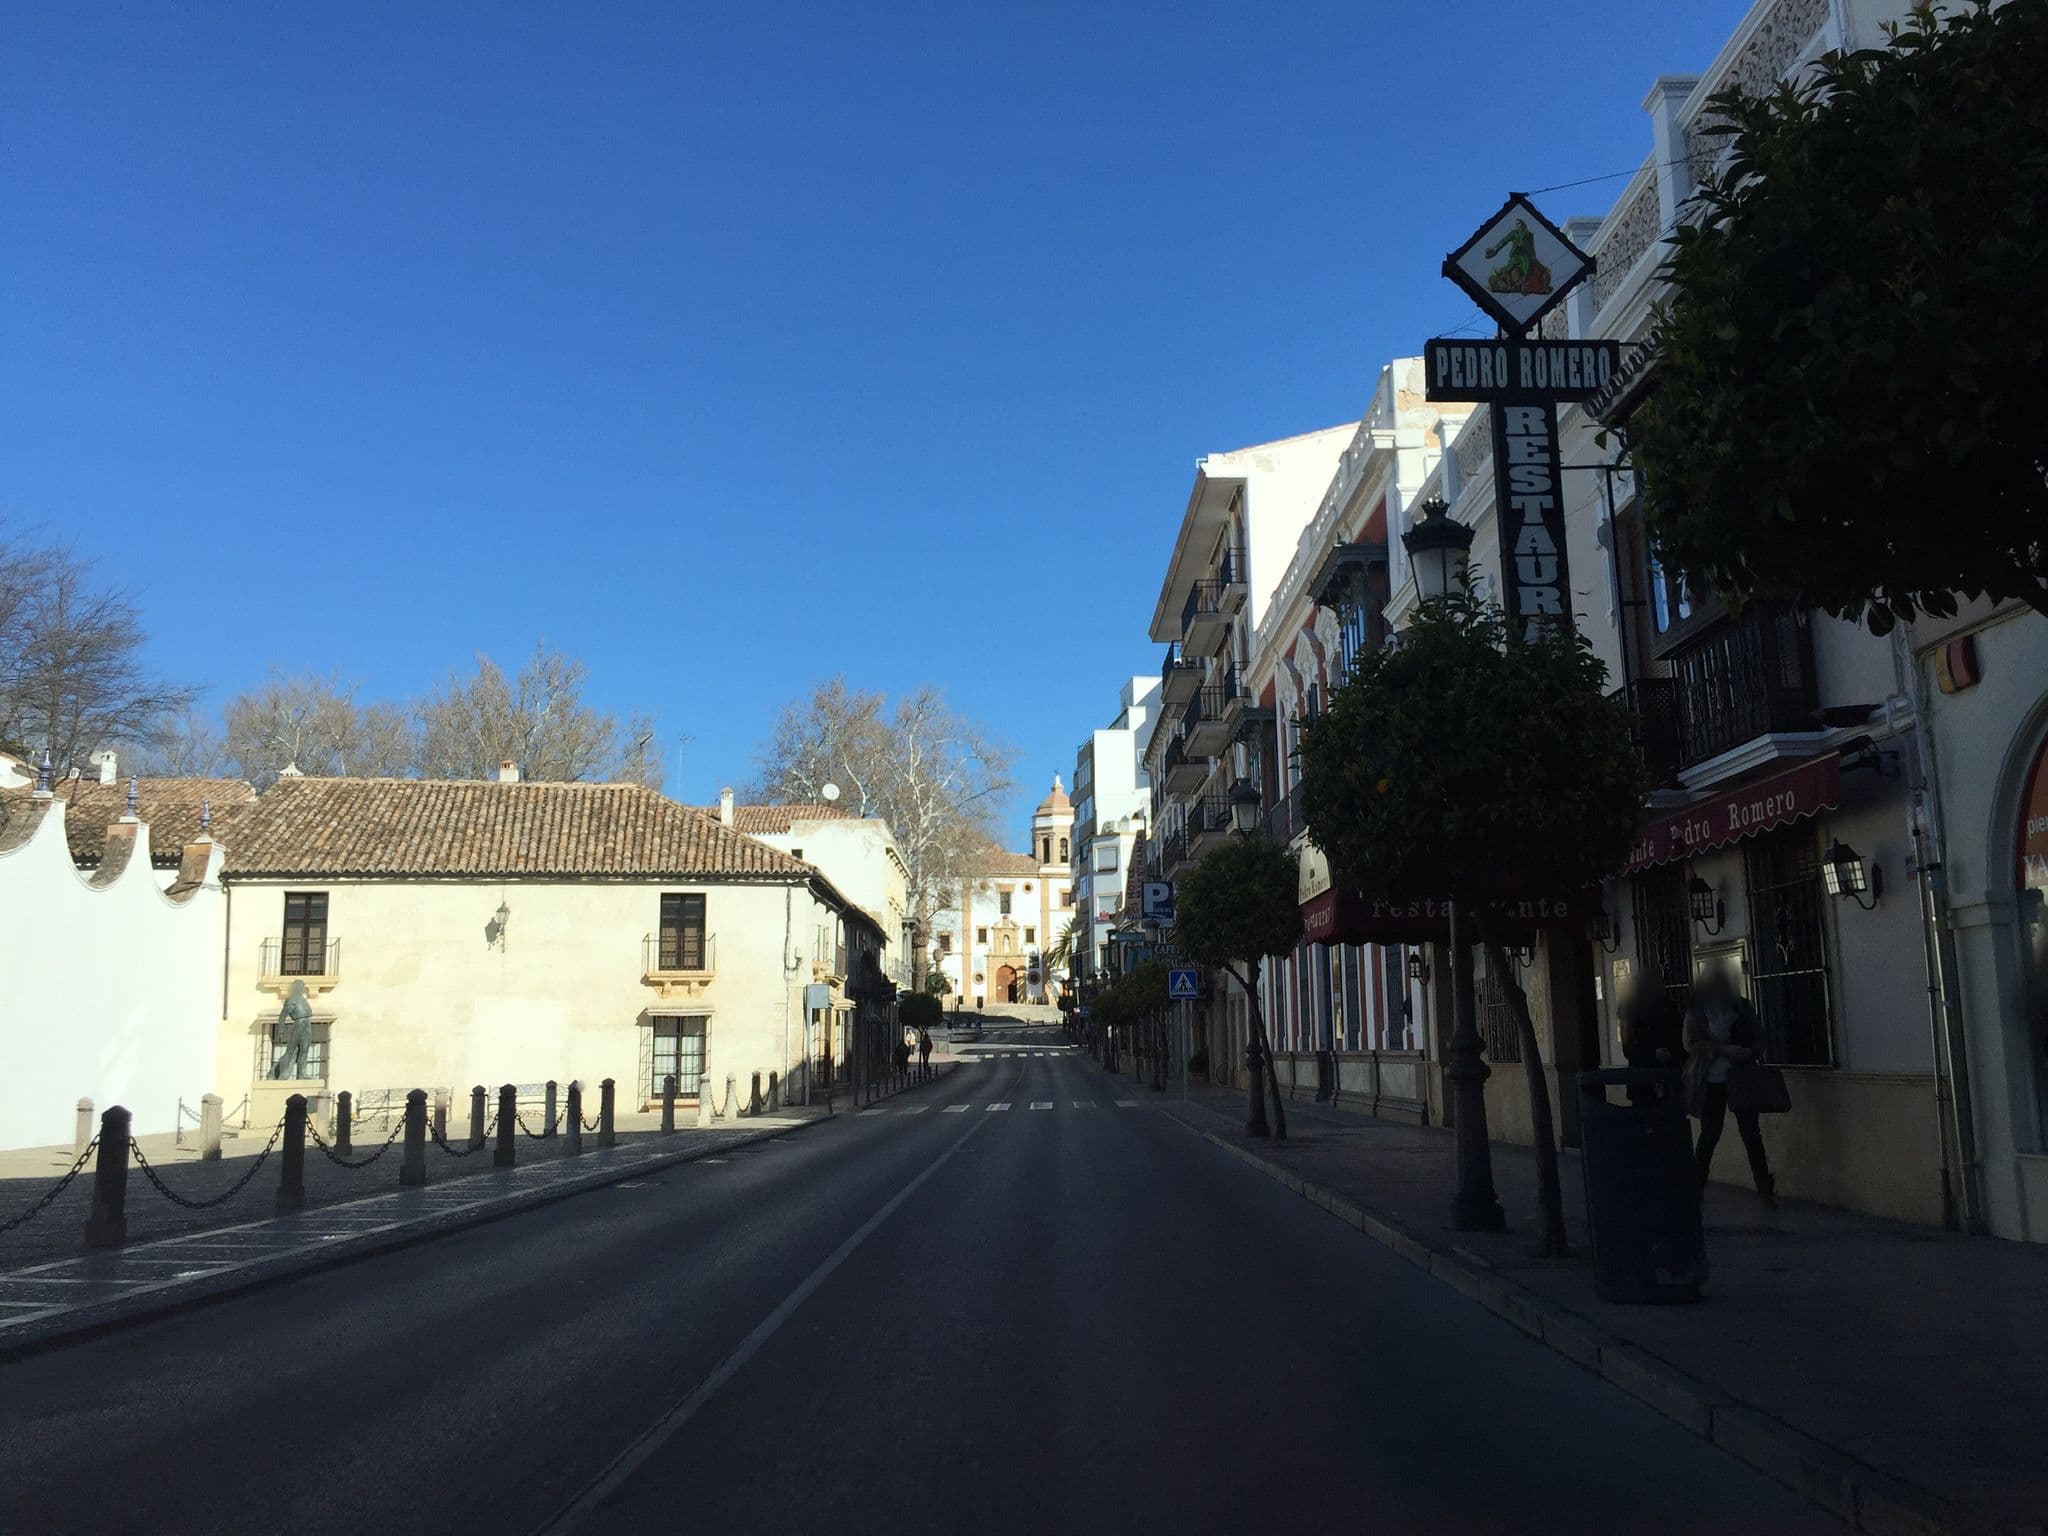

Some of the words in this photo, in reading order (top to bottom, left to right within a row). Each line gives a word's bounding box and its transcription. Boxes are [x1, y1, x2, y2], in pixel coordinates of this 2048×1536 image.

[1436, 346, 1508, 388] PEDRO
[1520, 346, 1611, 388] ROMERO
[1728, 790, 1795, 830] Romero
